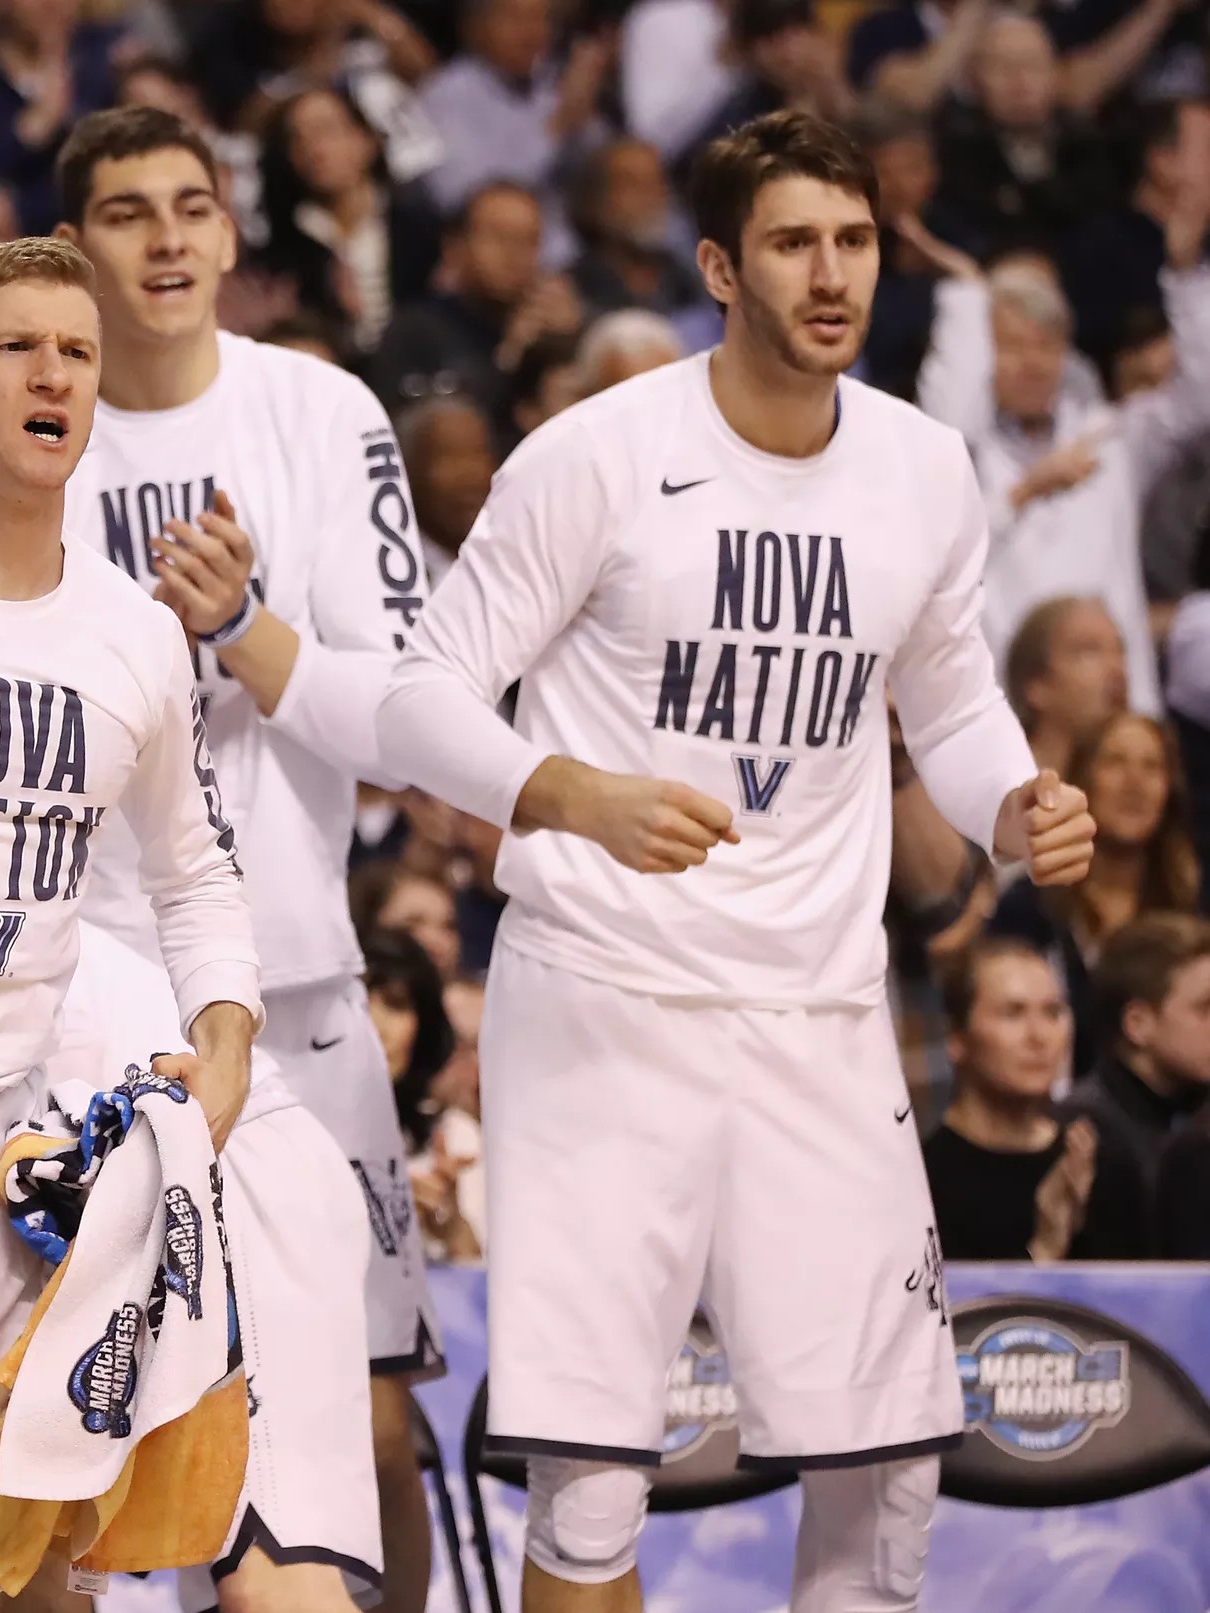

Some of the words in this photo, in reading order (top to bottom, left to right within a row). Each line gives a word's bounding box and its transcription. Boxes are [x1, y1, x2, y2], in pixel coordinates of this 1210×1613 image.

[710, 530, 853, 639] NOVA
[653, 640, 879, 748] NATION
[89, 1341, 114, 1411] MARCH
[112, 1306, 138, 1401] MADNESS
[979, 1353, 1076, 1387] MARCH
[994, 1381, 1124, 1416] MADNESS
